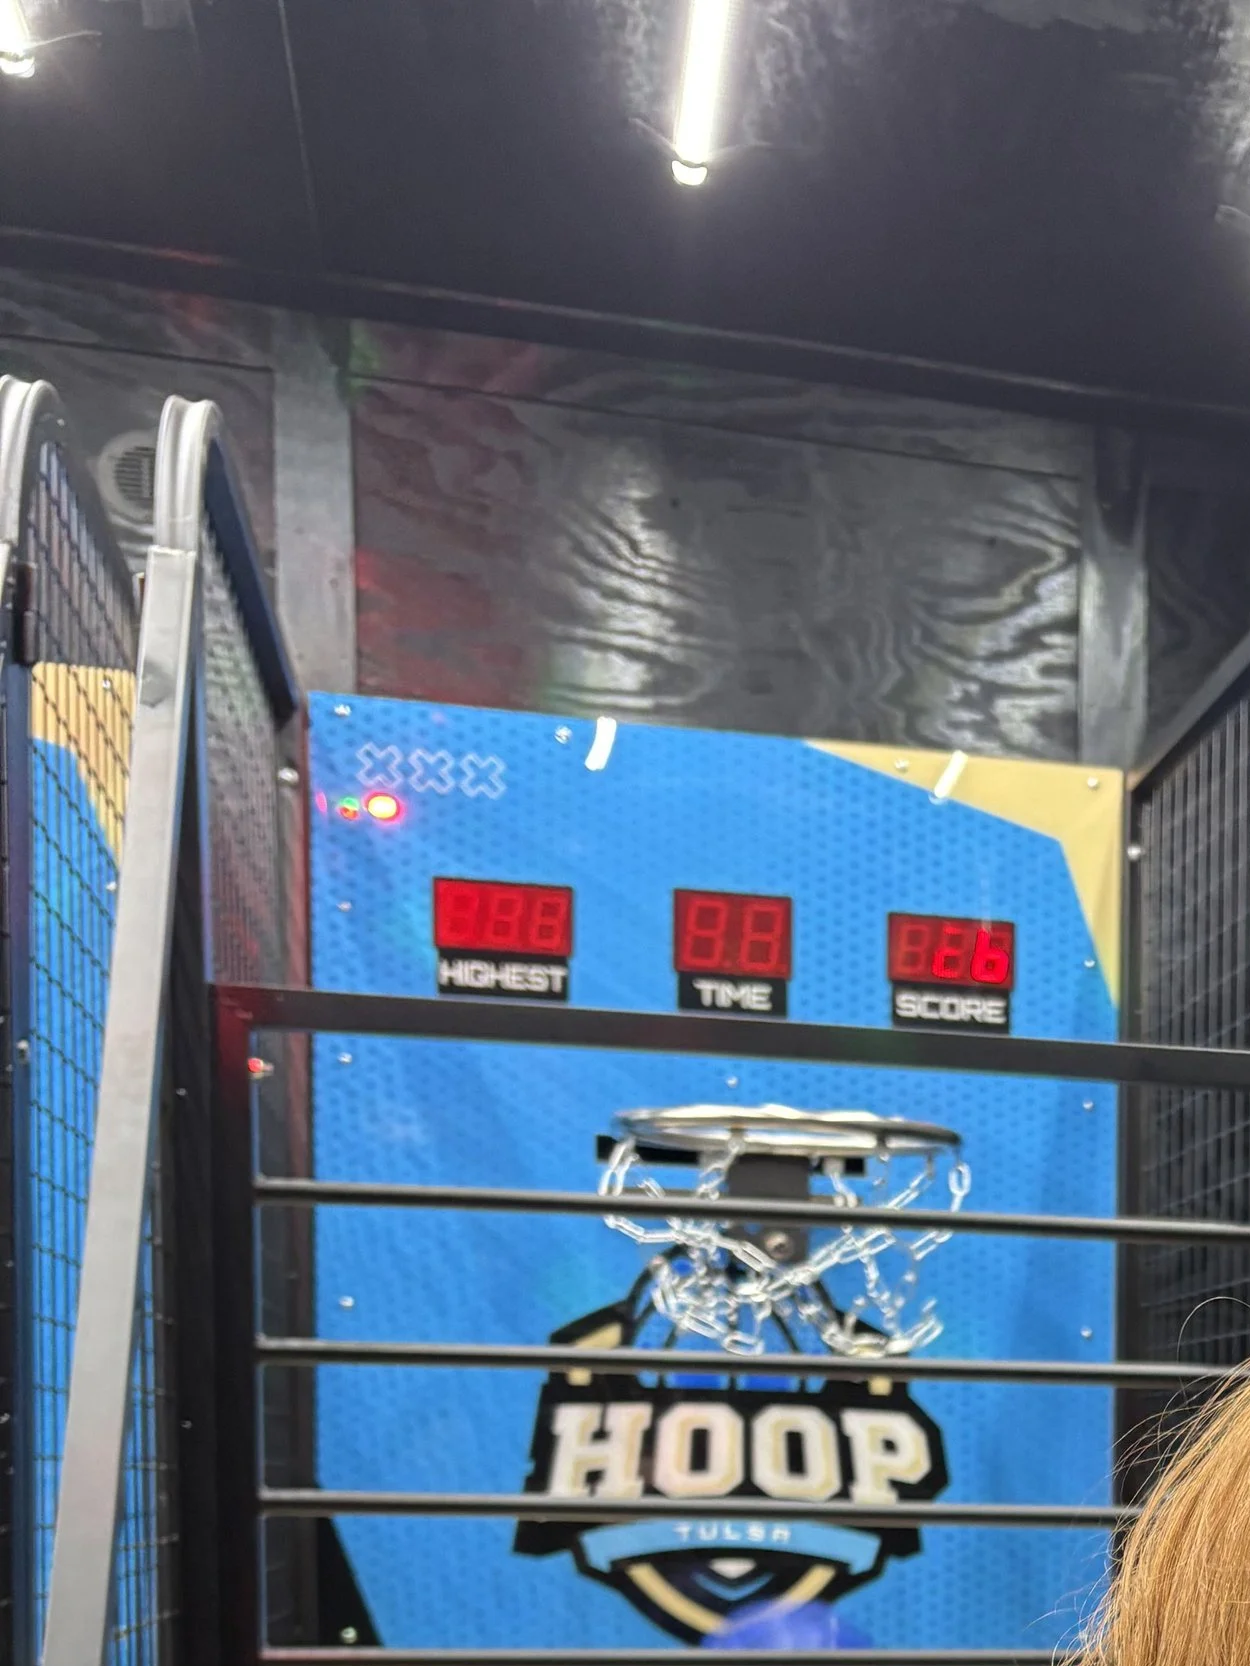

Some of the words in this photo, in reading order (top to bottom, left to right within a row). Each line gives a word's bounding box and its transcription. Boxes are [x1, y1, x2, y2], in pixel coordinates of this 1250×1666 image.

[438, 957, 568, 993] HIGHEST
[692, 979, 773, 1011] TIME
[895, 990, 1008, 1024] SCORE
[547, 1401, 932, 1504] HOOP
[673, 1523, 792, 1543] TULSA
